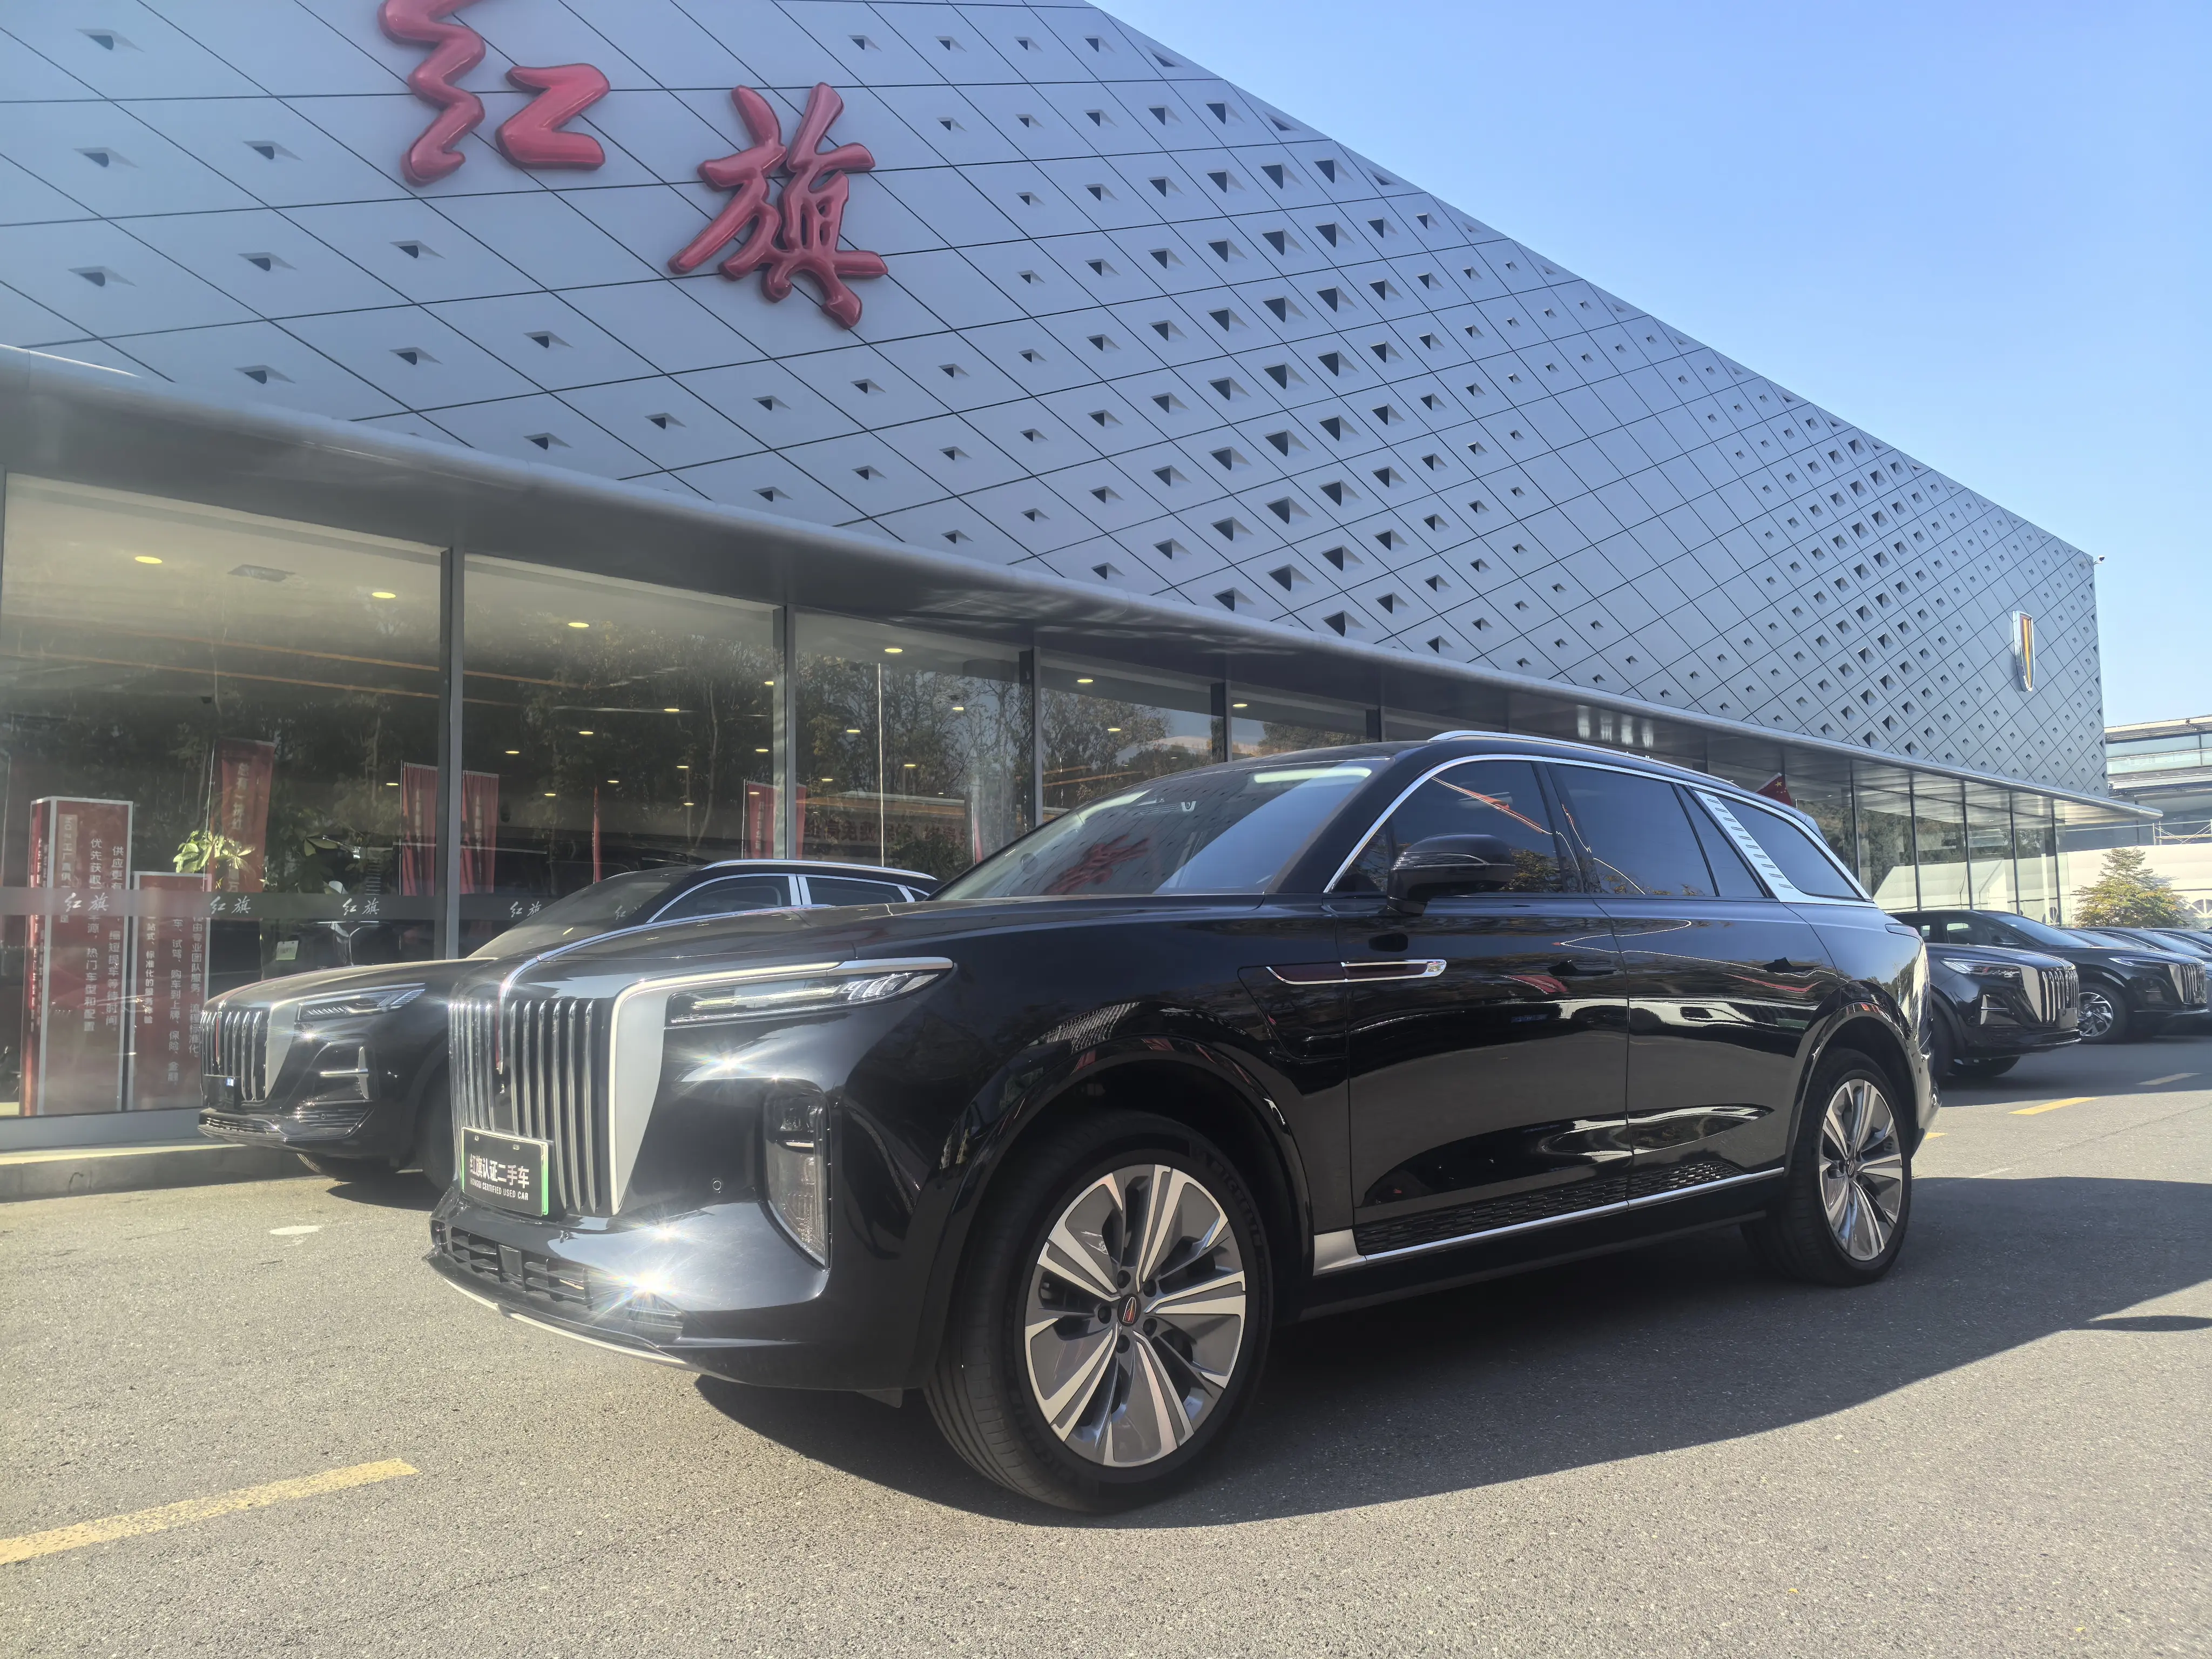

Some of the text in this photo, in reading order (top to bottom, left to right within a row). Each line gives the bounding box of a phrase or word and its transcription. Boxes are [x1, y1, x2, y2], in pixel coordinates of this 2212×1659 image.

[377, 0, 888, 329] 红旗
[64, 892, 109, 913] 红旗
[210, 895, 252, 914] 红旗
[342, 898, 380, 916] 红旗
[470, 1153, 530, 1189] 红旗认证二手车
[482, 1182, 502, 1195] CERTIFIED
[503, 1188, 516, 1198] USED
[517, 1191, 529, 1201] CAR
